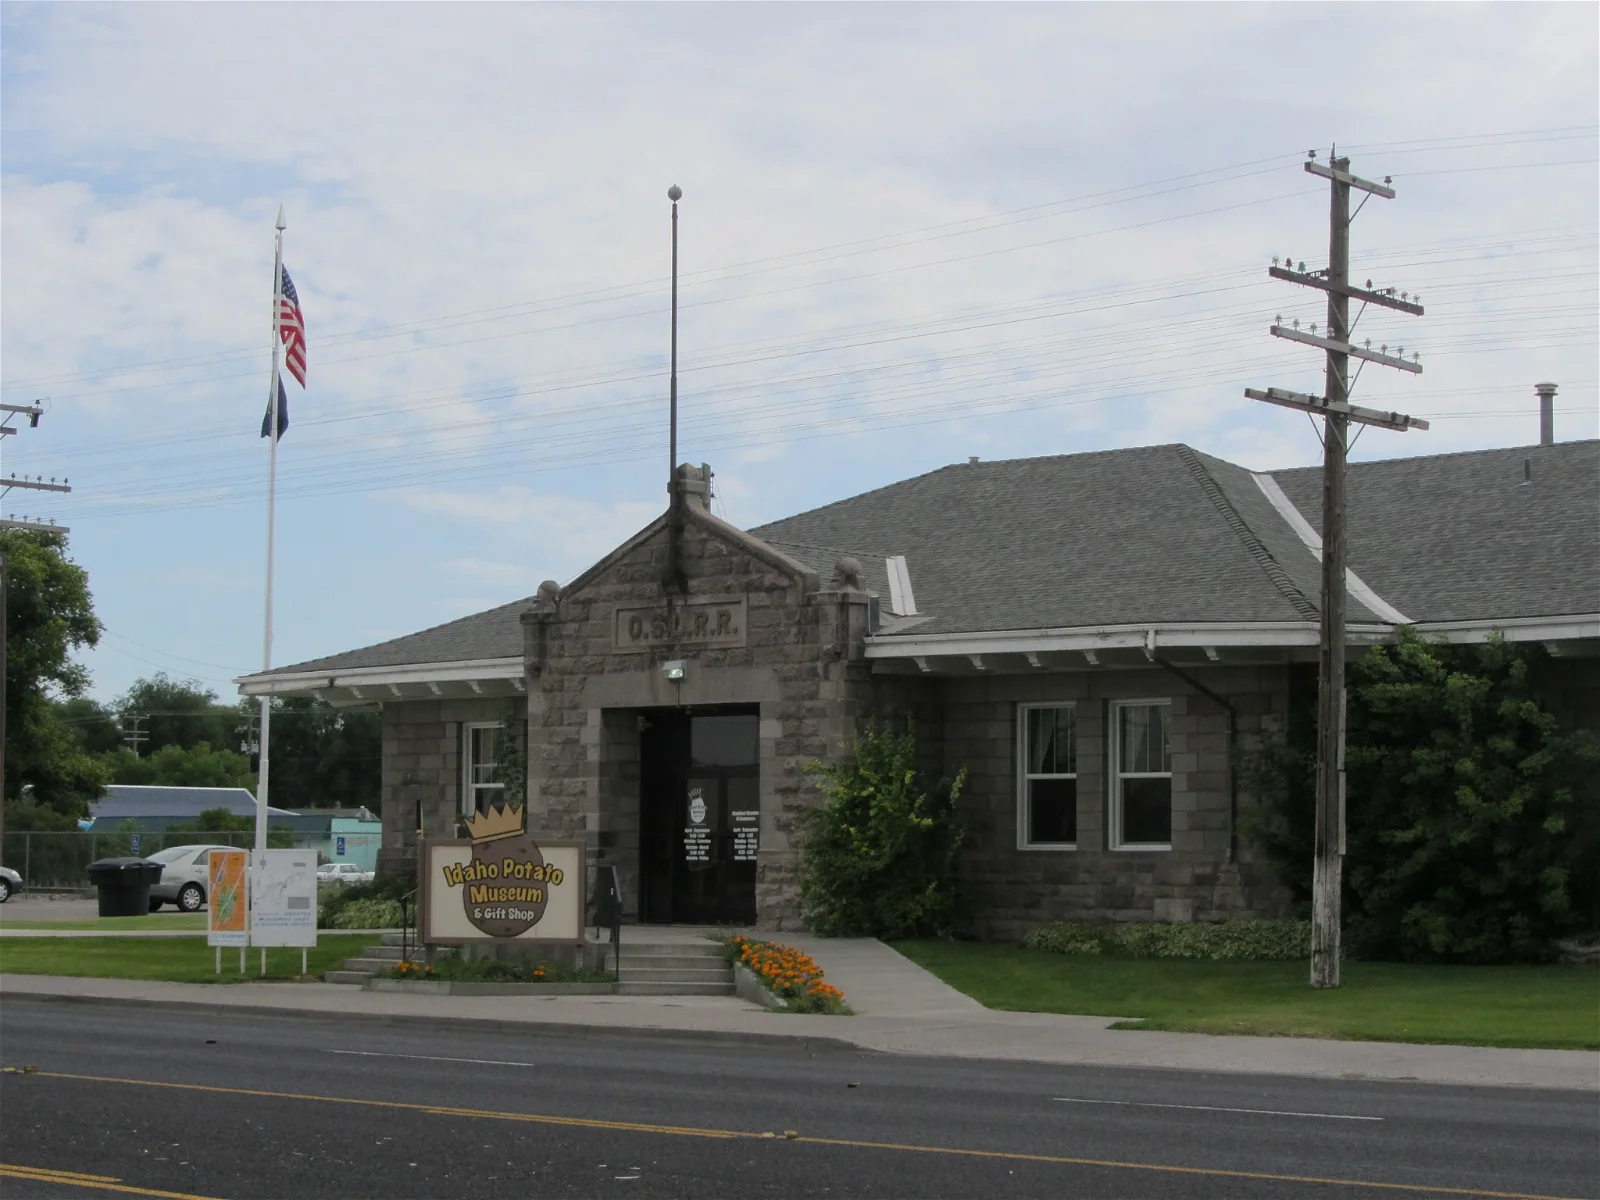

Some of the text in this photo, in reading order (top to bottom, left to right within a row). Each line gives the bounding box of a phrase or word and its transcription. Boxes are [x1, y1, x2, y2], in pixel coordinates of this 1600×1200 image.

[443, 858, 564, 887] Idaho Potato
[470, 885, 543, 904] Museum
[474, 908, 534, 921] & Gift Shop
